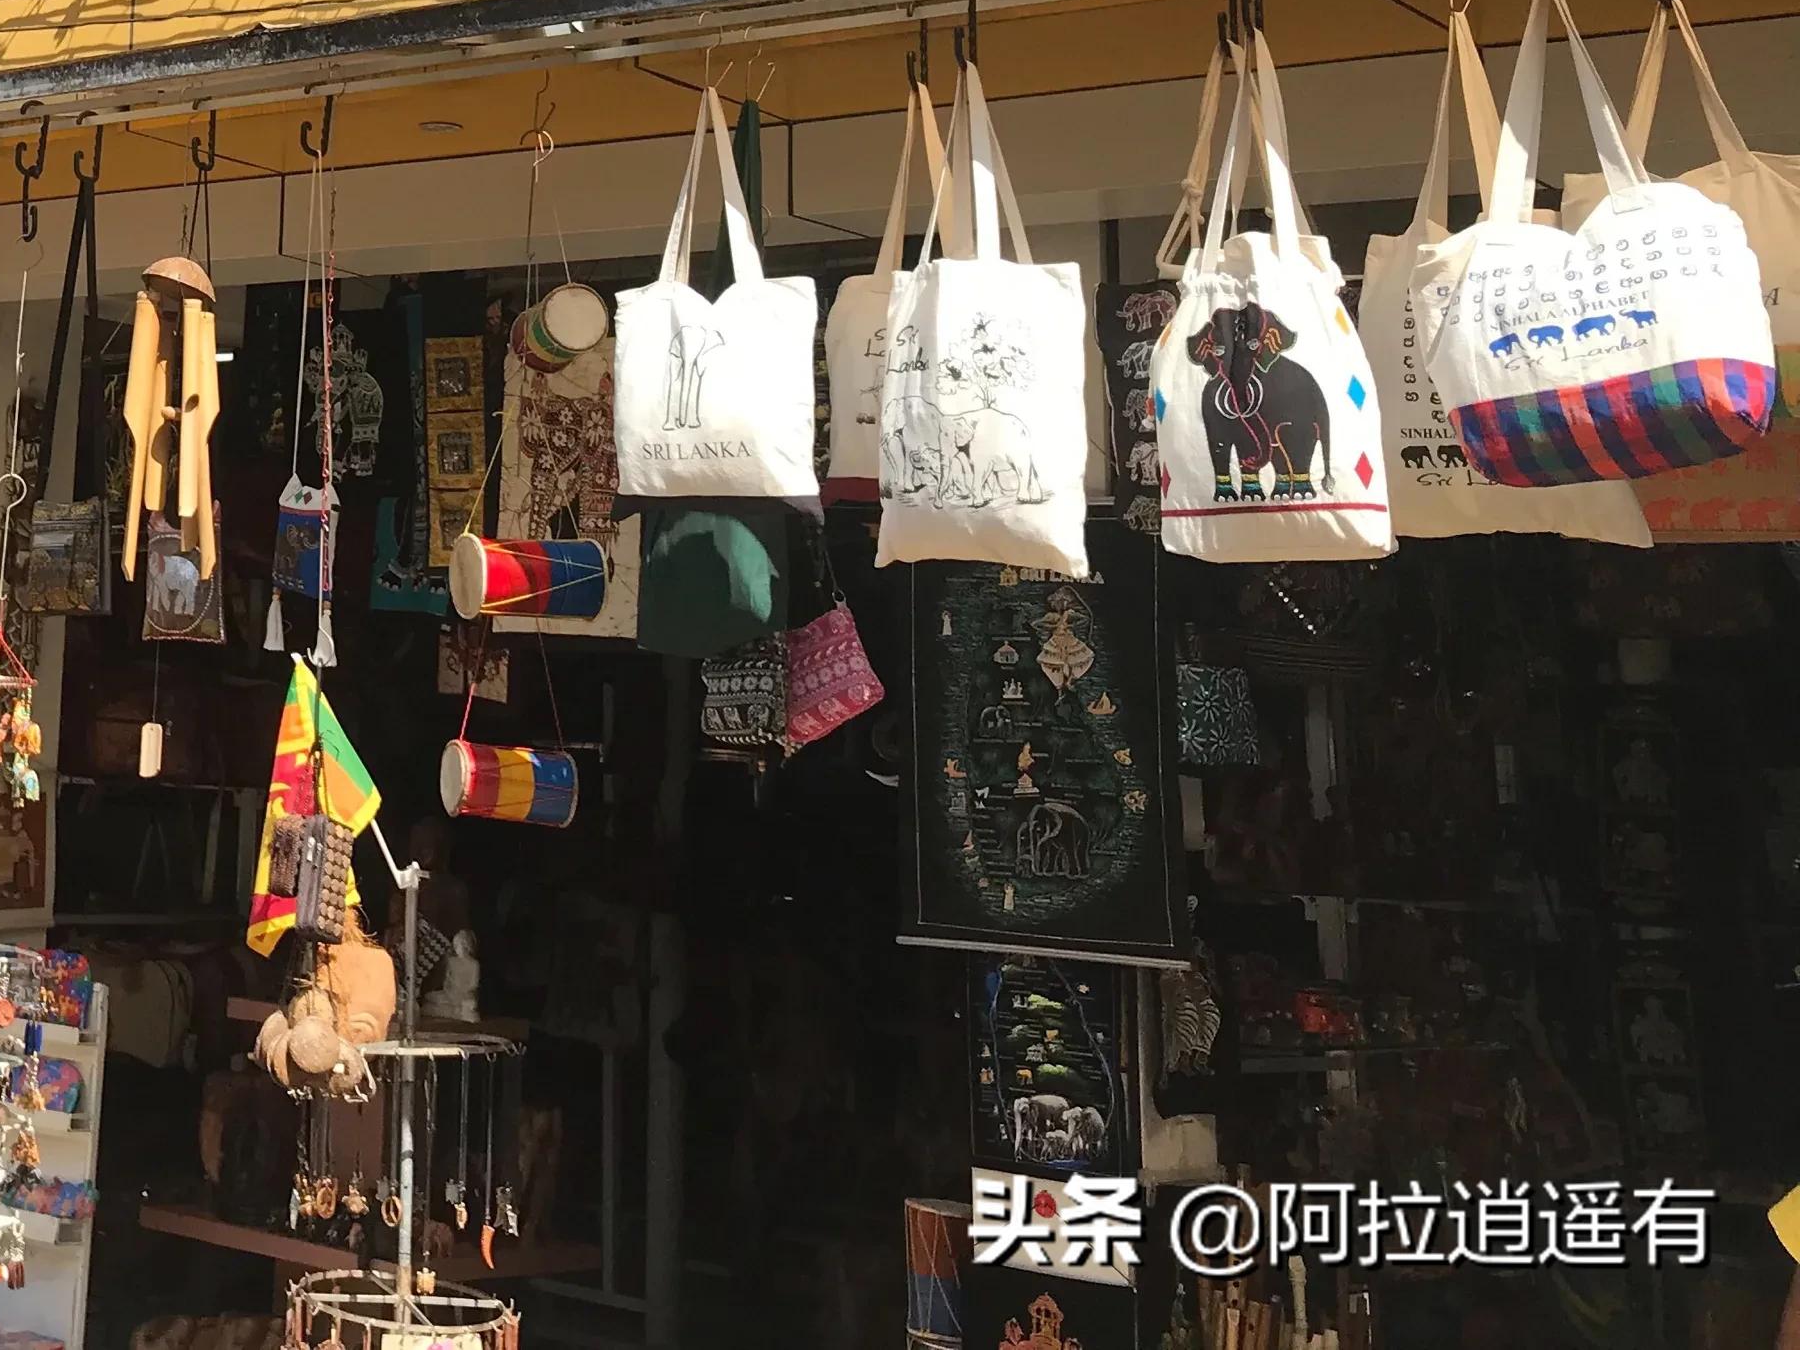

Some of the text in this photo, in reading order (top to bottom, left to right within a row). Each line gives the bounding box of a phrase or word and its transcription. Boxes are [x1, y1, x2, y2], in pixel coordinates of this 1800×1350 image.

[1561, 336, 1649, 361] Lanka
[1400, 427, 1457, 439] SINHAL
[642, 440, 752, 461] SRI LANKA
[1417, 472, 1452, 487] Sri
